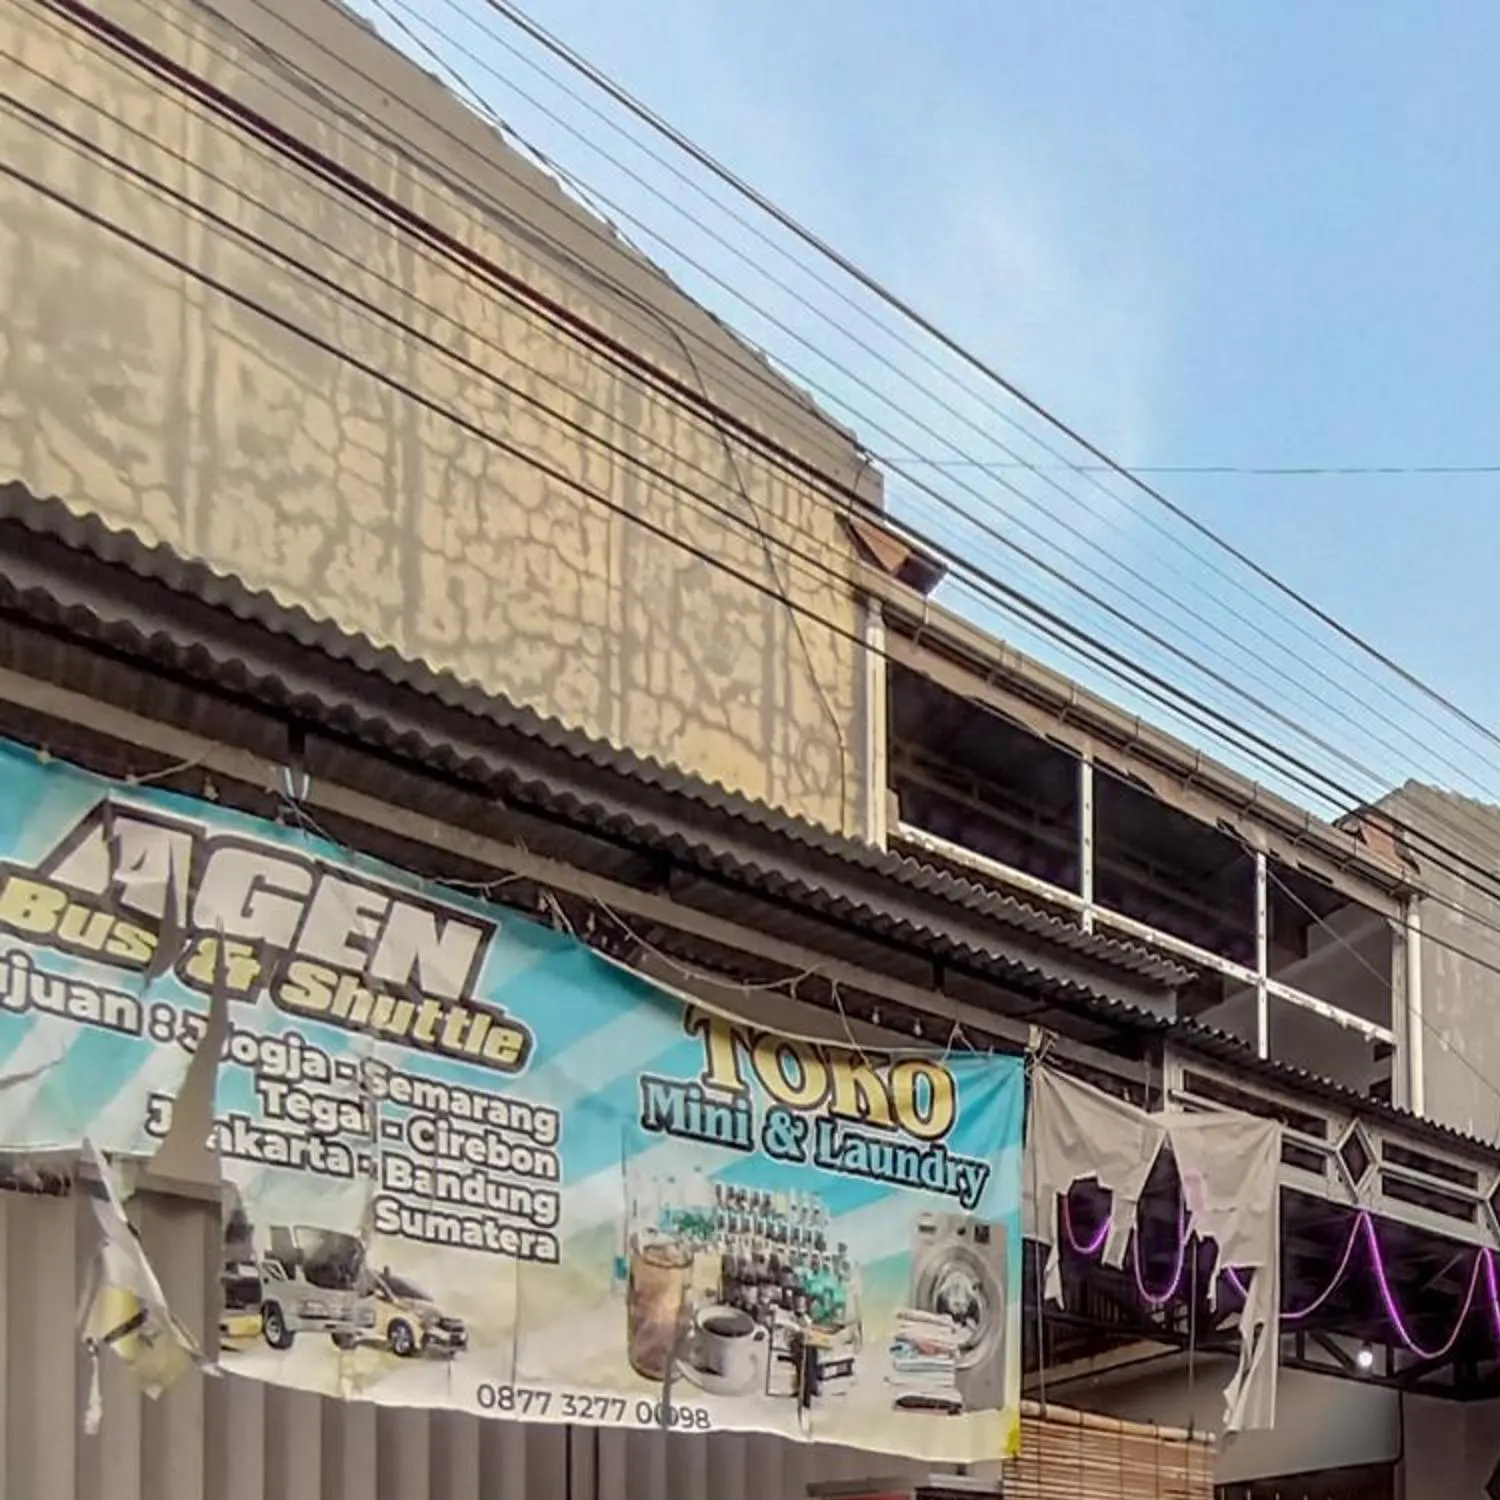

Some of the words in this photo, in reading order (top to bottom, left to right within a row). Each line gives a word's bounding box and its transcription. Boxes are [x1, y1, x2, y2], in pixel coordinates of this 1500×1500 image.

[44, 805, 490, 1000] AGEN
[0, 876, 160, 962] Bus
[279, 960, 525, 1064] Shuttle
[0, 952, 143, 1036] juan
[364, 1060, 560, 1143] Semarang
[686, 1005, 954, 1137] TOKO
[259, 1082, 373, 1137] Tegal
[408, 1117, 559, 1180] Cirebon
[384, 1155, 559, 1224] Bandung
[642, 1072, 752, 1148] Mini
[766, 1108, 804, 1160] &
[815, 1122, 988, 1206] Laundry
[374, 1198, 560, 1260] Sumatera
[477, 1383, 552, 1416] 0877
[561, 1393, 627, 1422] 3277
